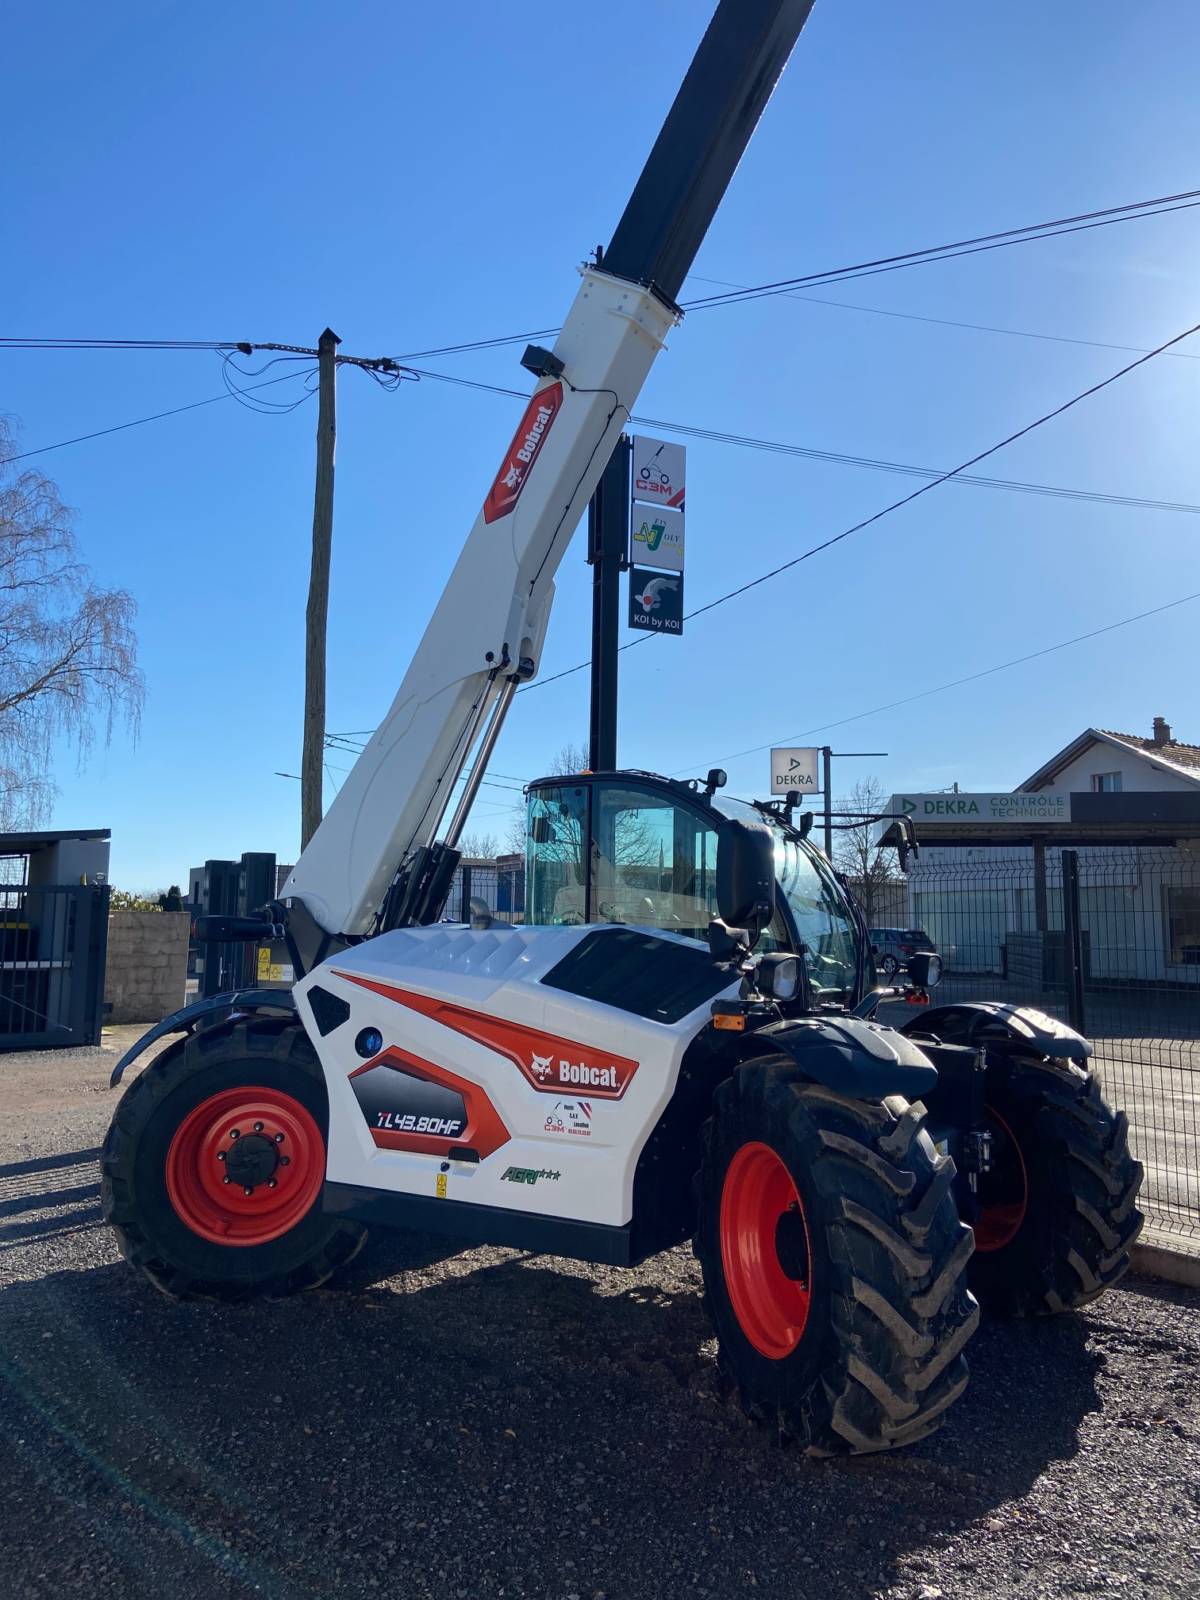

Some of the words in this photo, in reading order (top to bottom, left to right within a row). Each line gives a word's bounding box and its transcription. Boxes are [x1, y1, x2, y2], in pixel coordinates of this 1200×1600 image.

[516, 405, 553, 463] Bobcat
[634, 614, 649, 625] KOI
[651, 616, 663, 628] by
[664, 618, 680, 629] KOI
[776, 775, 814, 785] DEKRA
[924, 800, 980, 815] DEKRA
[990, 796, 1065, 806] CONTRÔLE
[991, 808, 1065, 817] TECHNIQUE
[559, 1060, 617, 1088] Bobcat
[501, 1166, 539, 1185] AGRI
